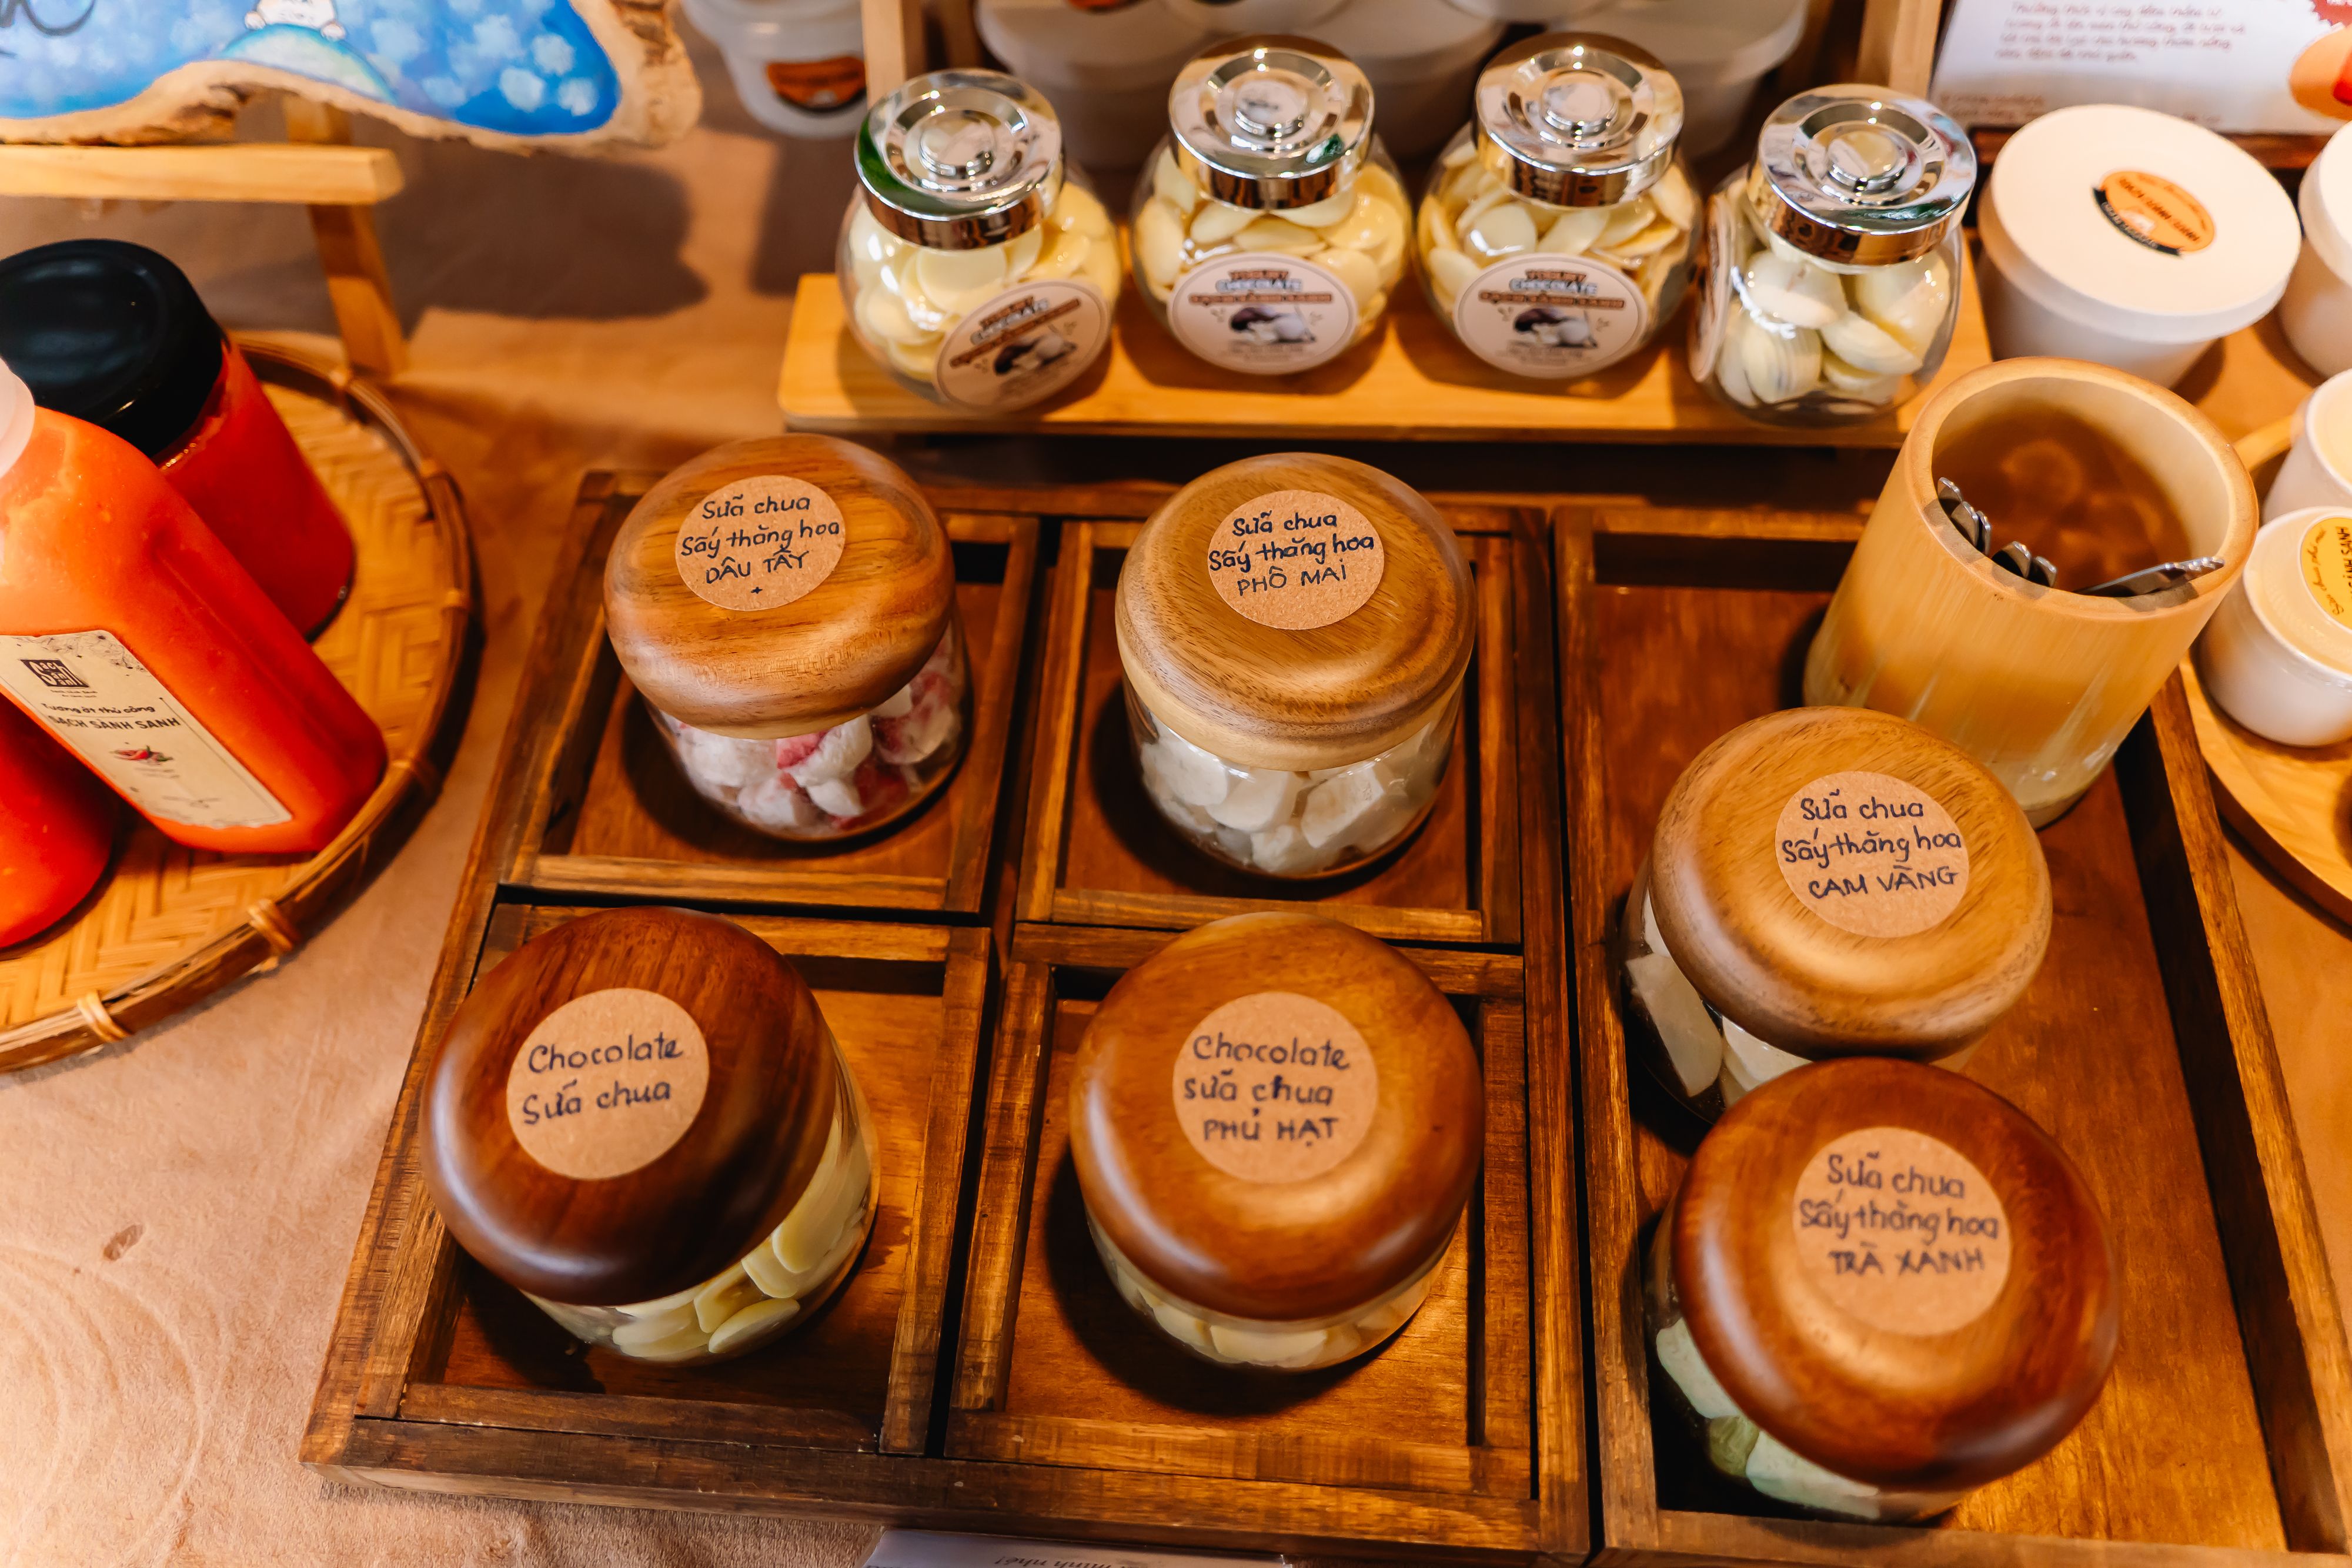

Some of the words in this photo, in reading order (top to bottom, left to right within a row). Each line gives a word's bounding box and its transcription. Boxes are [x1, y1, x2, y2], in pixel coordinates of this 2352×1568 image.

[702, 494, 743, 519] Sữa
[754, 496, 810, 513] chua
[1232, 510, 1272, 536] Sữa
[1284, 513, 1337, 530] chua
[681, 527, 720, 558] Sấy
[726, 524, 793, 549] thăng
[800, 519, 840, 539] hoa
[1209, 540, 1251, 573] Sấy
[1255, 537, 1326, 564] thăng
[1333, 533, 1374, 553] hoa
[706, 556, 750, 584] DÂU
[763, 549, 809, 573] TÂY
[1237, 566, 1287, 596] PHÔ
[135, 717, 181, 729] SANH
[1800, 788, 1847, 820] Sữa
[1859, 796, 1924, 820] chua
[1782, 827, 1829, 869] Sấy
[1829, 830, 1910, 862] thăng
[1913, 825, 1962, 850] hoa
[1808, 874, 1868, 899] CAM
[528, 1031, 684, 1074] Chocolate
[1193, 1032, 1351, 1070] Chocolate
[596, 1081, 670, 1109] chua
[1252, 1075, 1333, 1106] chua
[1203, 1107, 1259, 1141] PHỦ
[1277, 1118, 1339, 1147] HẠT
[1892, 1165, 1965, 1199] chua
[1800, 1189, 1849, 1239] Sấy
[1853, 1200, 1940, 1246] thăng
[1946, 1208, 1998, 1239] hoa
[1896, 1247, 1984, 1276] XANH
